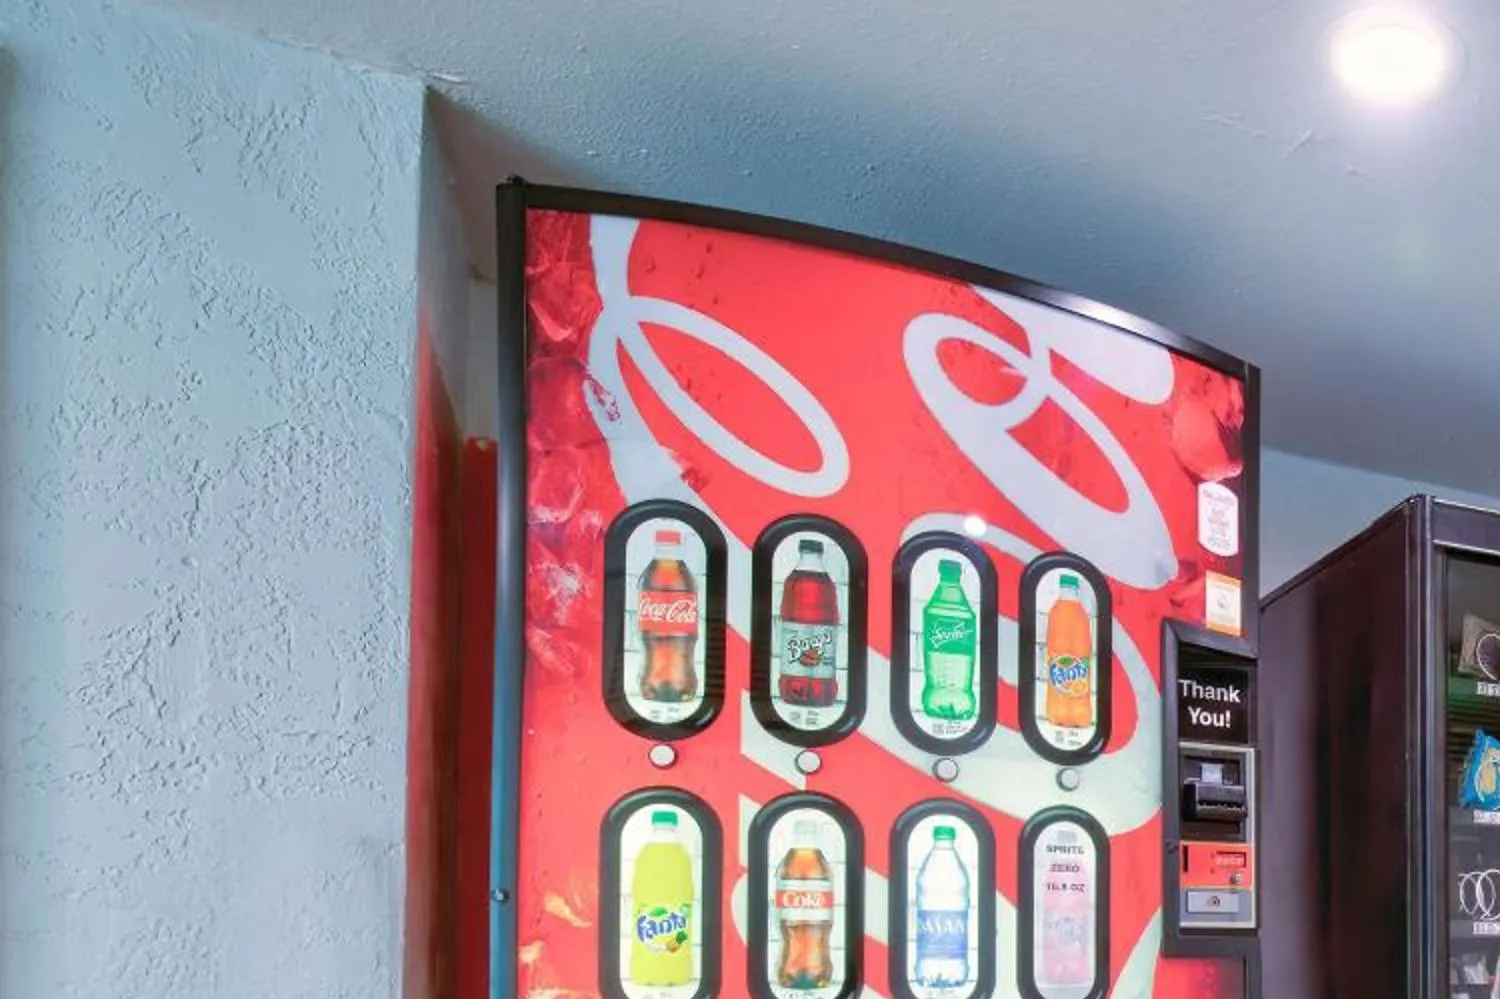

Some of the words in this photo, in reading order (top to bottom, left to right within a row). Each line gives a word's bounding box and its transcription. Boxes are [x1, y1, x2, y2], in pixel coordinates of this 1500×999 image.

[1178, 679, 1241, 703] Thank
[1187, 706, 1232, 728] You!
[782, 890, 827, 908] Coke
[636, 911, 688, 943] Fanta
